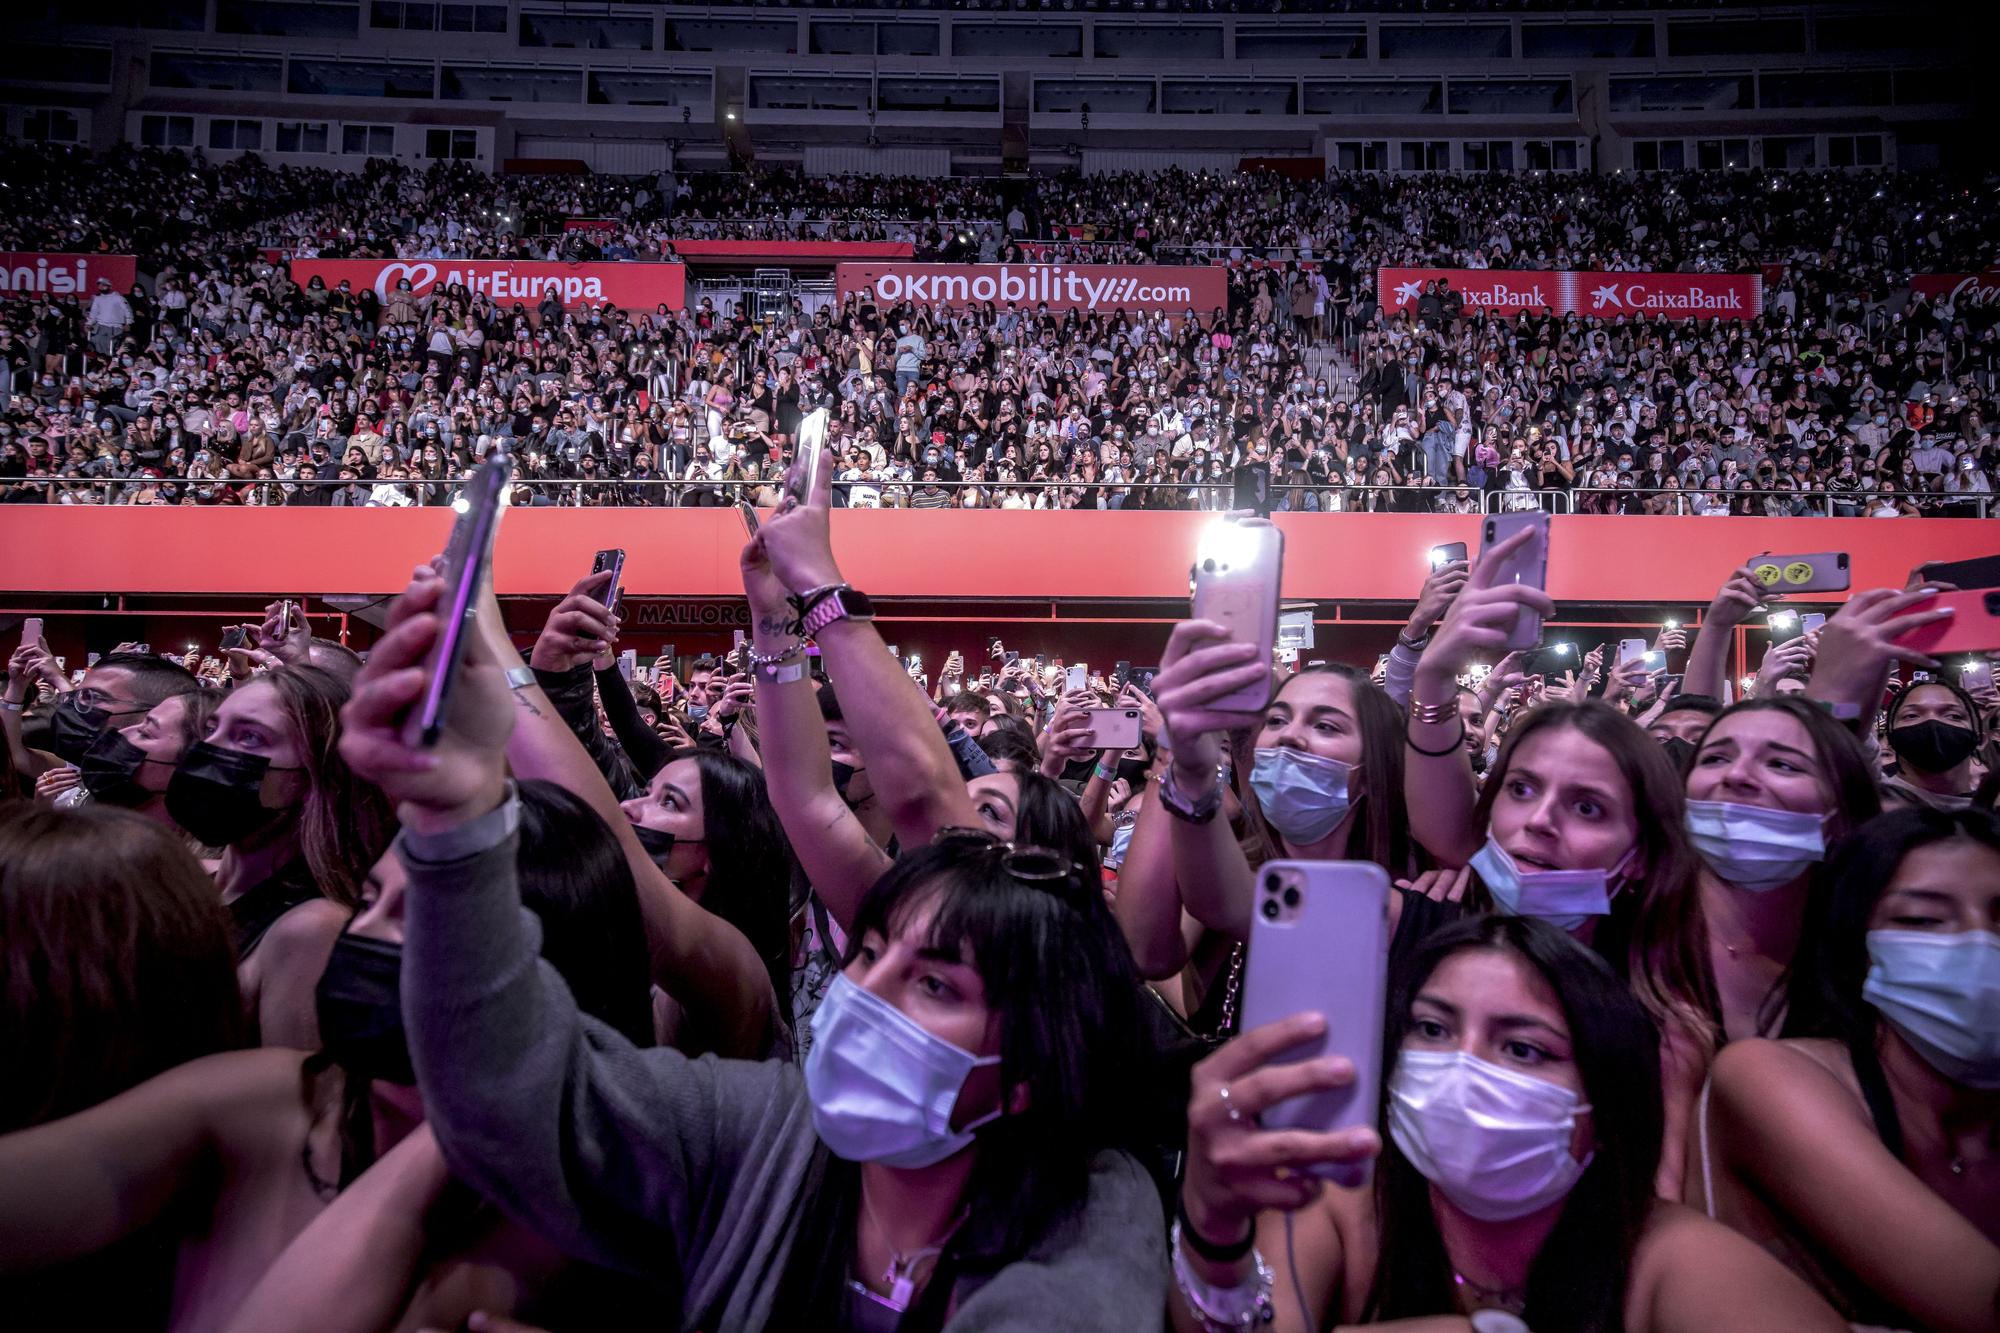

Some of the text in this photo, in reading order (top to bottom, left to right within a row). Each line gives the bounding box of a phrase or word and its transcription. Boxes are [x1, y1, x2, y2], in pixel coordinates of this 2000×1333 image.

[1462, 284, 1546, 306] ixaBank
[1625, 285, 1742, 309] CaixaBank
[638, 604, 752, 625] MALLORC
